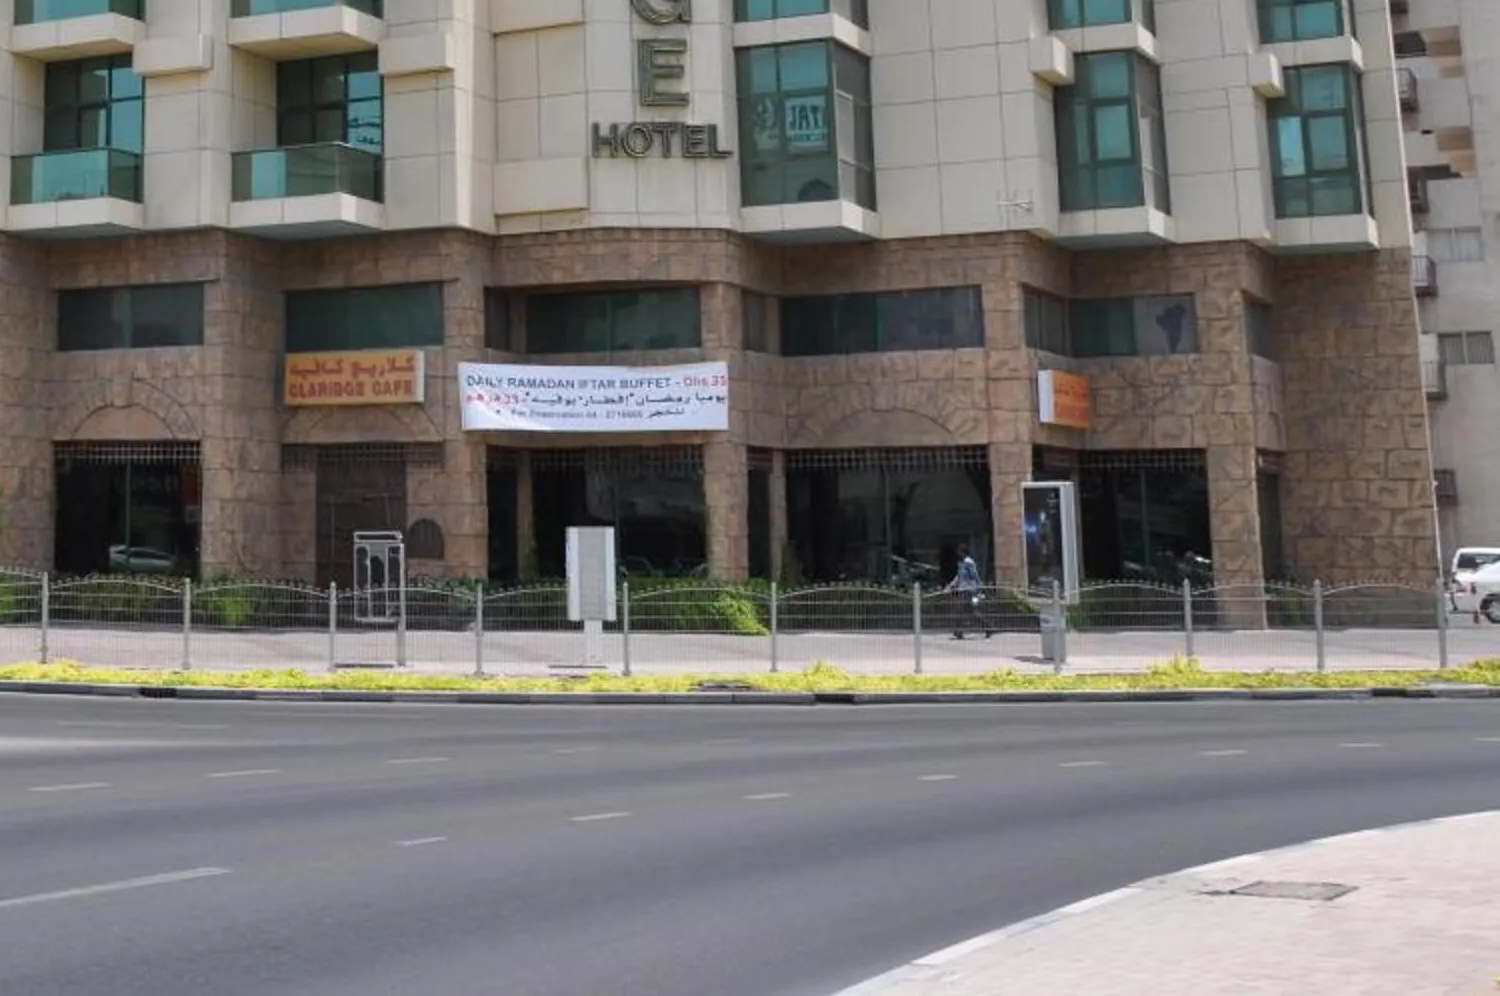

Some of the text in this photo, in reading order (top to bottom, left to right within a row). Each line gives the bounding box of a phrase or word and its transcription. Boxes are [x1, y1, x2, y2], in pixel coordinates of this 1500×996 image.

[591, 122, 733, 158] HOTEL
[288, 380, 413, 398] CLARIDGE CAFE
[467, 375, 501, 387] DAILY
[507, 377, 575, 389] RAMADAN
[619, 377, 671, 389] BUFFET
